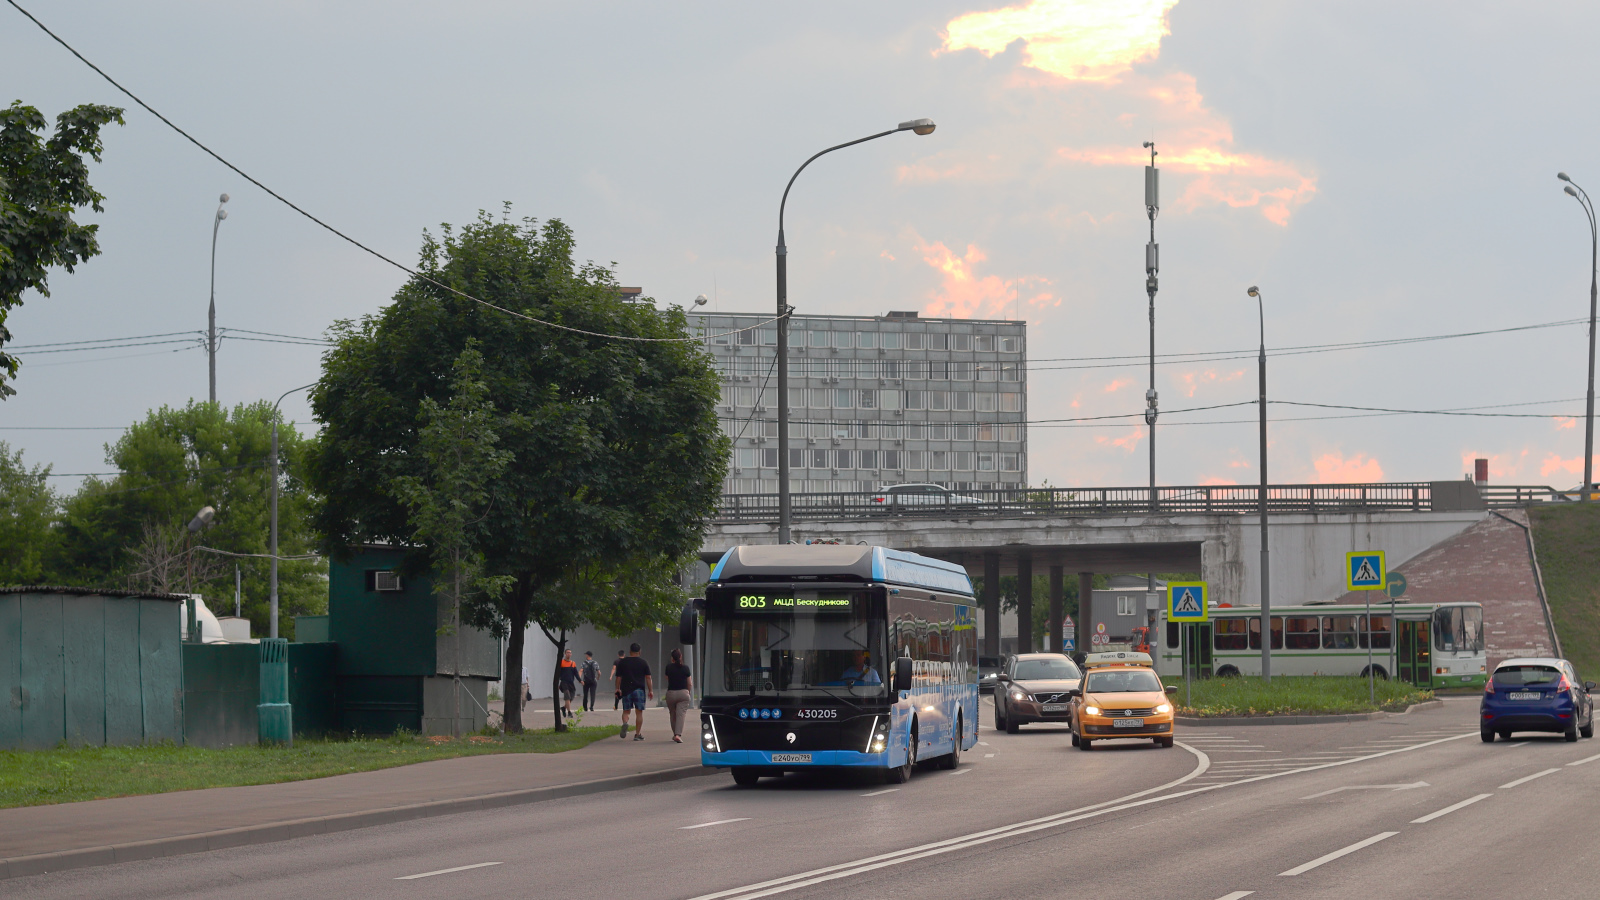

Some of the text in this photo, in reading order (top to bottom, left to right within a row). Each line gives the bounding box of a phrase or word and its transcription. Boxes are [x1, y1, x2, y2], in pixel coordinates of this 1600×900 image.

[740, 595, 850, 608] 803 МЦД Бескудниково
[797, 709, 837, 719] 430205
